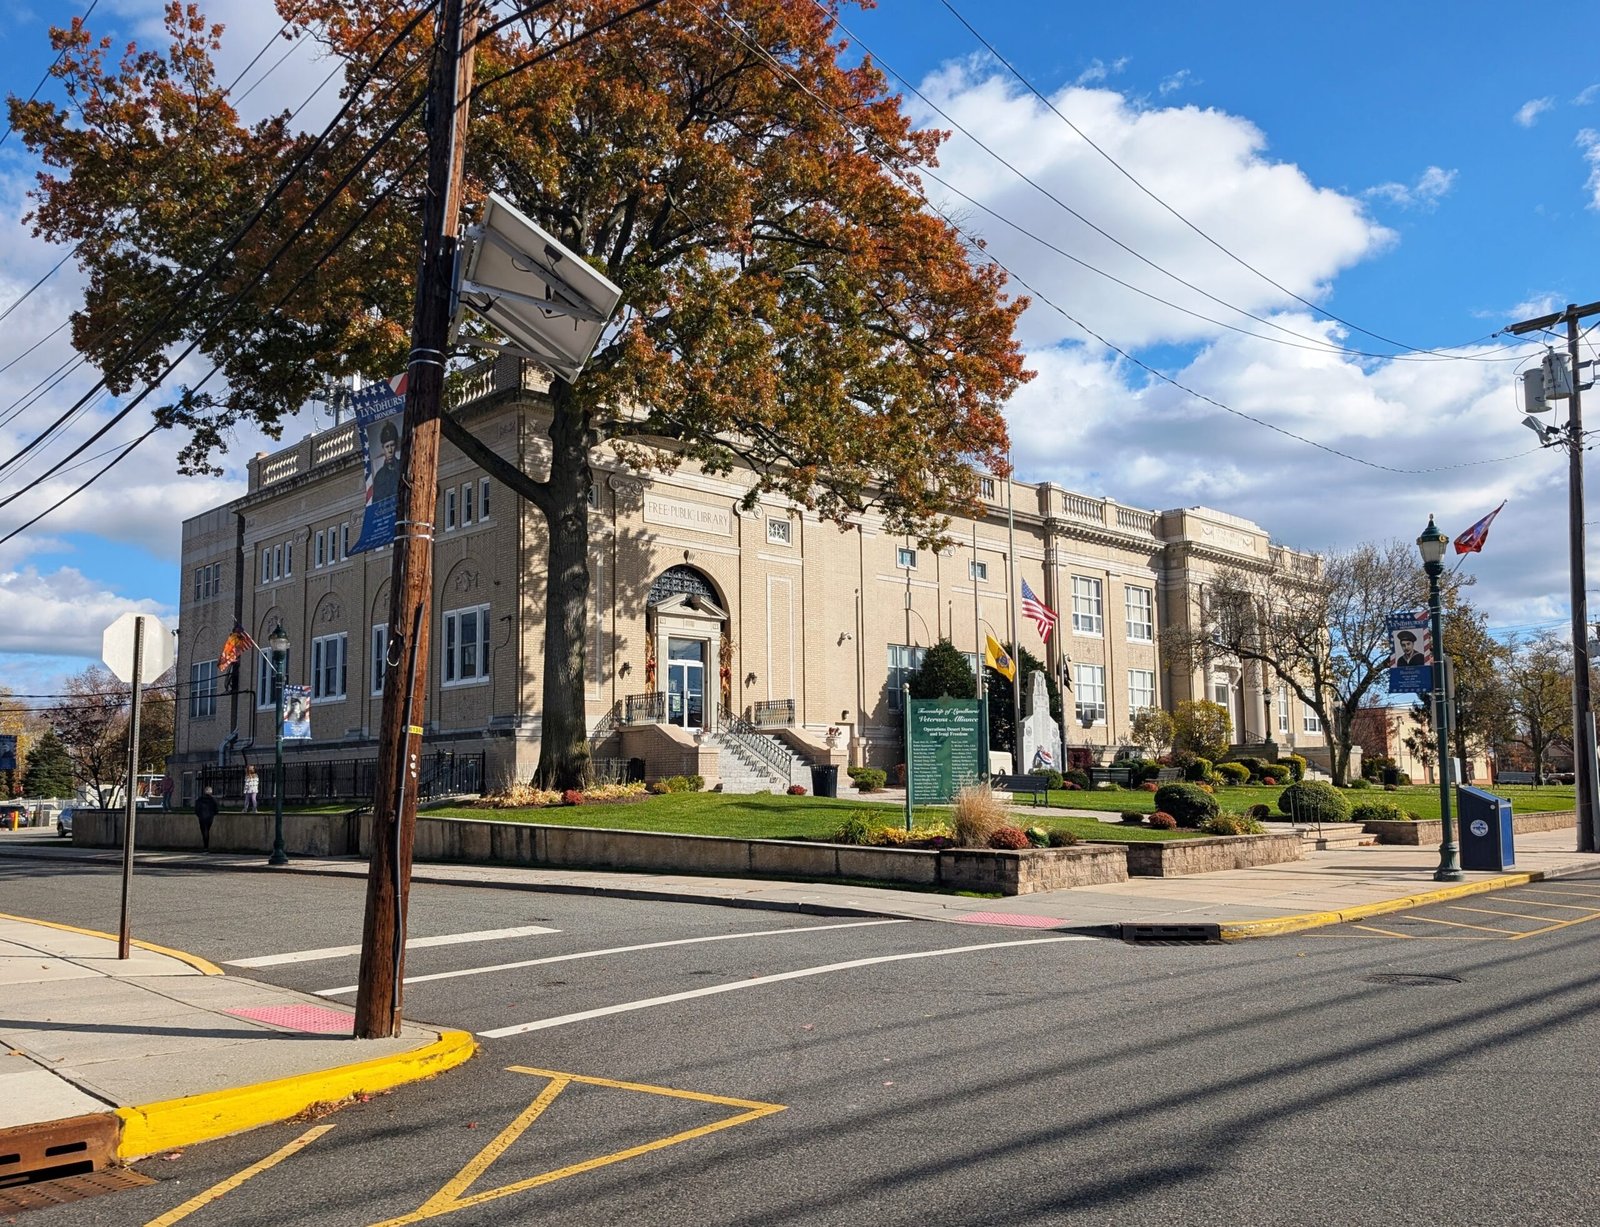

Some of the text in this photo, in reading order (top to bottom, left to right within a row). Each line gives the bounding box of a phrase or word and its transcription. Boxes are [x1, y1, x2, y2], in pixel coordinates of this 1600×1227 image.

[360, 394, 406, 418] LYNDHURST
[648, 501, 729, 526] FREE PUBLIC LIBRARY
